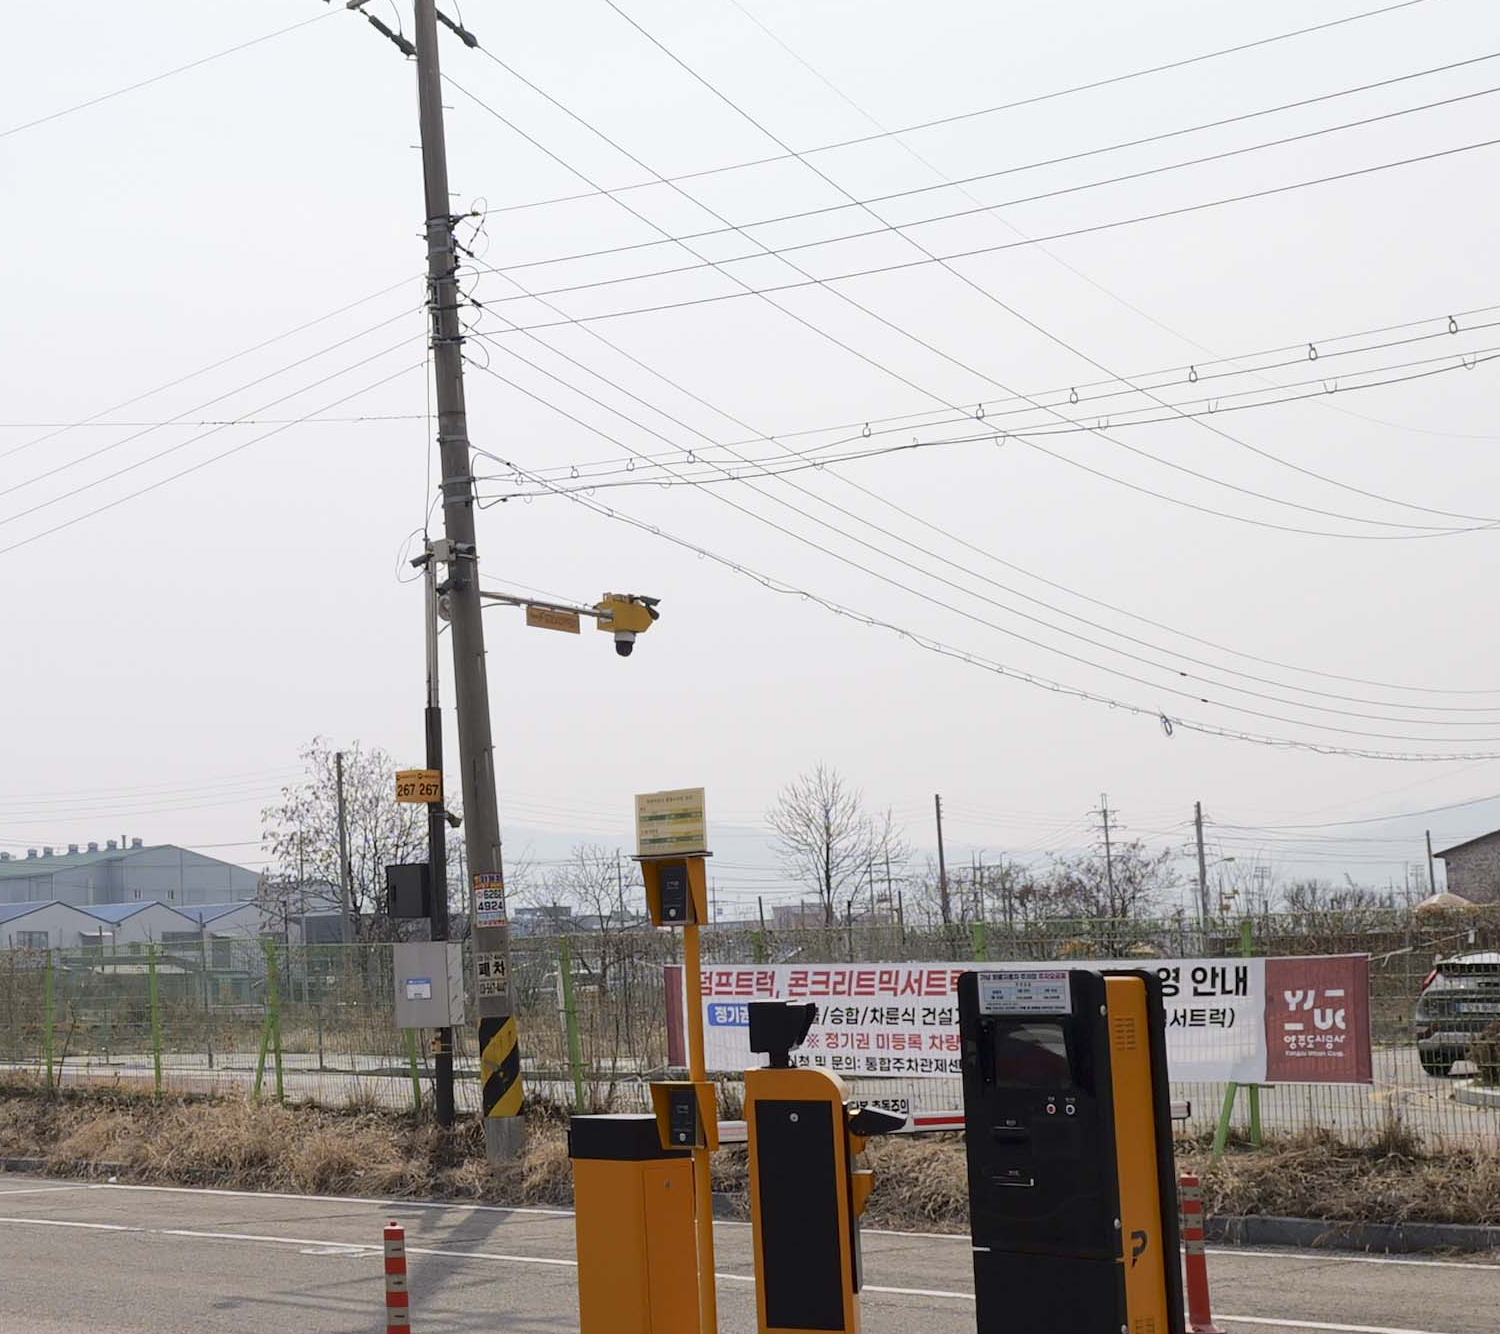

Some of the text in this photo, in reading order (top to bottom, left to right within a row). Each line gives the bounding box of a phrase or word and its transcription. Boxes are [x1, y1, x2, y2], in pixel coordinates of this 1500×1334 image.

[397, 784, 439, 797] 267 267
[1191, 966, 1248, 997] 안내
[1166, 1008, 1235, 1028] 서트럭)
[825, 1032, 870, 1051] 정기권
[876, 1033, 924, 1052] 미등록
